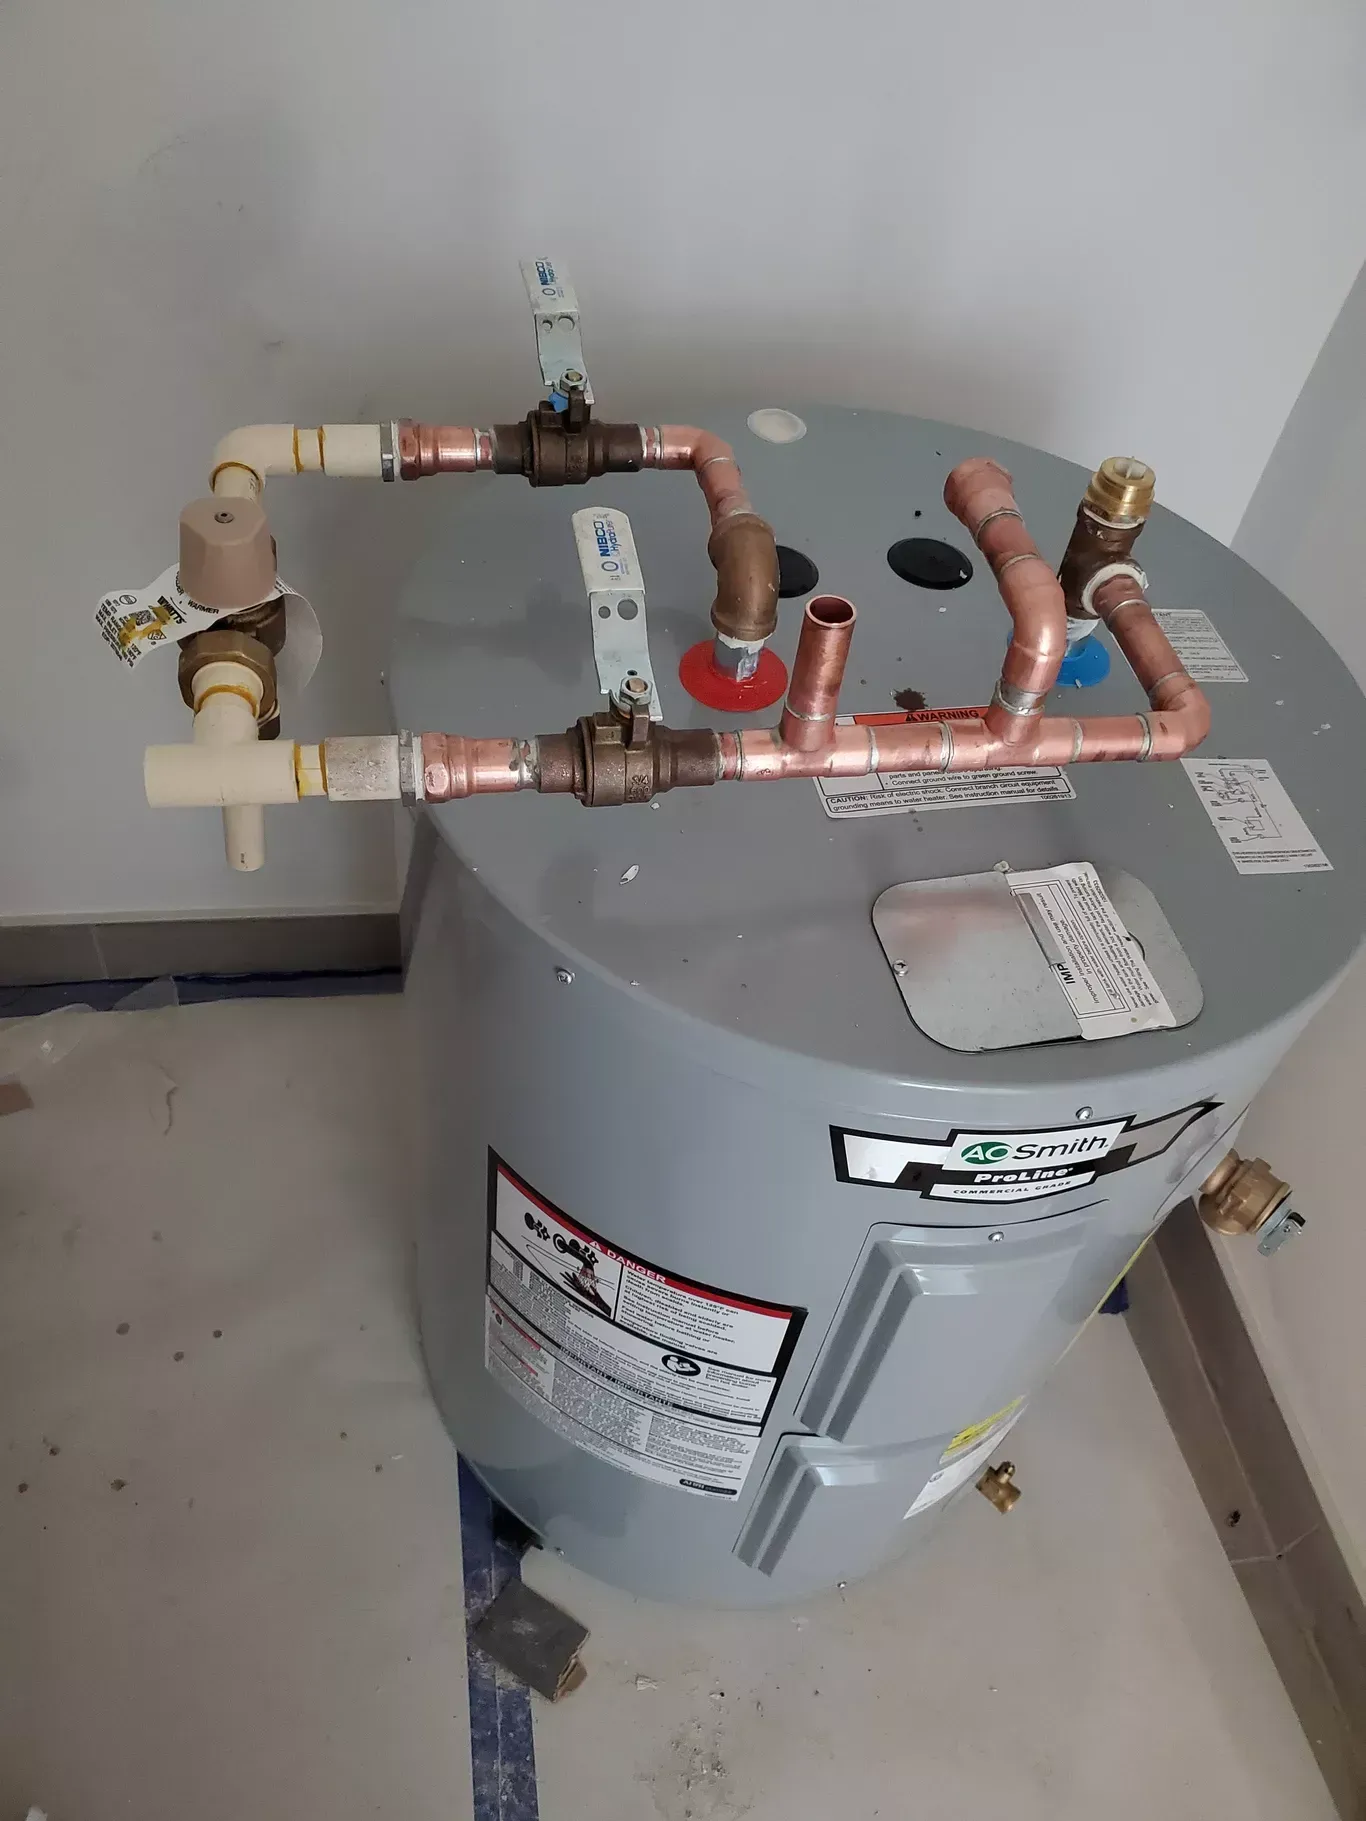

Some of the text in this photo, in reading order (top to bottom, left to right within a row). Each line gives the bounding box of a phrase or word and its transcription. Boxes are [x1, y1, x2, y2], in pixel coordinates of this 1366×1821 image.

[593, 520, 610, 557] NIBCO
[158, 596, 184, 625] WATTS
[187, 599, 220, 615] WARMER
[915, 709, 980, 721] WARNING
[891, 777, 921, 786] Connect
[922, 775, 946, 784] ground
[971, 772, 990, 780] green
[991, 770, 1016, 778] ground
[830, 794, 868, 804] CAUTION:
[895, 789, 920, 797] electric
[944, 784, 973, 793] Connect
[1020, 779, 1055, 787] equipment
[832, 801, 869, 812] grounding
[869, 799, 893, 807] means
[903, 796, 921, 804] water
[922, 794, 947, 802] heater.
[948, 792, 963, 800] See
[964, 789, 999, 798] instruction
[1000, 787, 1025, 795] manual
[1035, 892, 1100, 1004] Improper installation and use may result
[1071, 943, 1090, 967] property
[1012, 1136, 1108, 1160] Smith
[974, 1167, 1070, 1183] ProLine
[953, 1181, 1072, 1195] COMMERCIAL GRADE
[607, 1249, 667, 1284] DANGER
[646, 1279, 687, 1298] temperature
